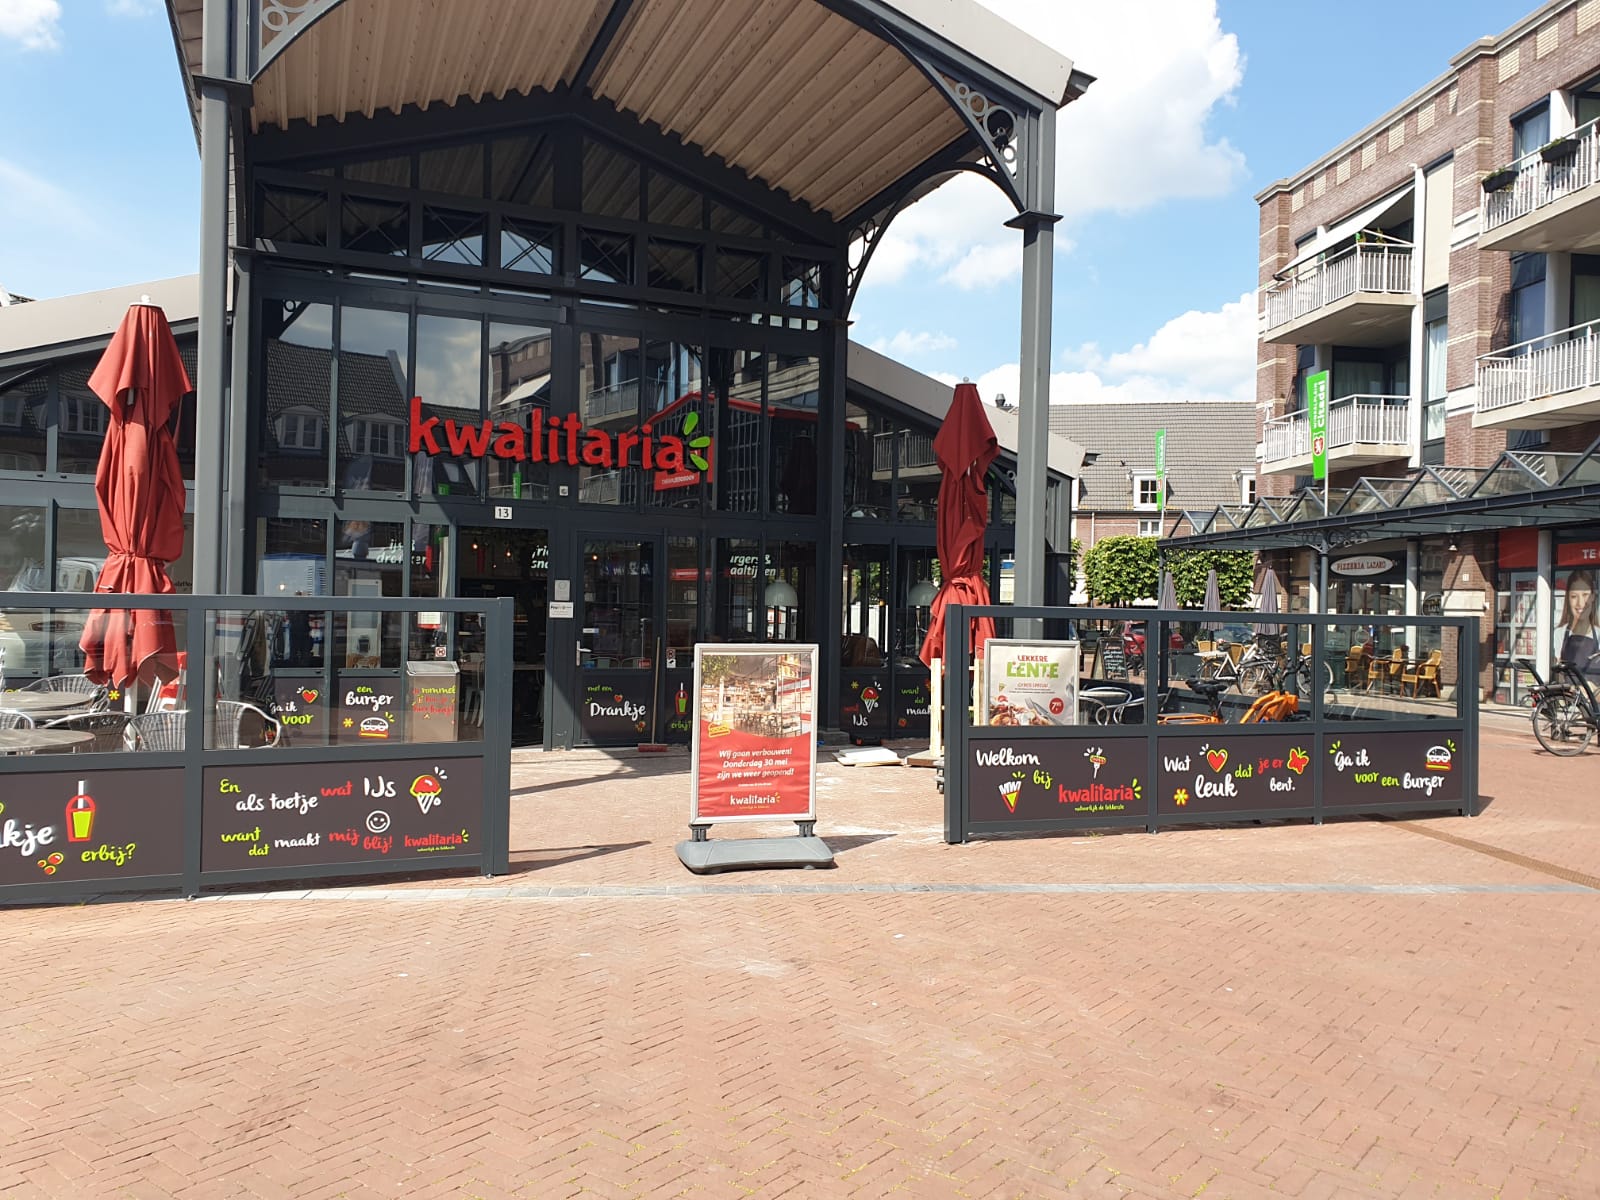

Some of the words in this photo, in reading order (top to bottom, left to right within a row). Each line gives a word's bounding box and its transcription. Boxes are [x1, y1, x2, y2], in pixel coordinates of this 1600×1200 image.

[408, 396, 684, 472] kwalitaria
[496, 508, 510, 519] 13
[1582, 549, 1596, 559] TE
[1007, 662, 1059, 678] LENTE
[356, 686, 373, 694] een
[901, 686, 920, 695] want
[285, 701, 297, 712] ik
[590, 701, 646, 721] Drankje
[906, 705, 931, 715] maak
[282, 714, 314, 725] voor
[719, 750, 732, 759] Wij
[733, 750, 750, 758] gaan
[752, 747, 792, 757] verbouwen!
[976, 747, 1040, 767] Welkom
[1334, 751, 1354, 772] Ga
[1355, 748, 1371, 767] ik
[723, 760, 763, 769] Donderdag
[775, 758, 788, 766] mei
[1163, 755, 1191, 772] Wat
[717, 771, 730, 780] zijn
[762, 768, 795, 778] geopend!
[1033, 769, 1053, 789] bij
[1194, 773, 1238, 798] leuk
[1234, 764, 1253, 778] dat
[1257, 758, 1270, 775] je
[1271, 759, 1284, 768] er
[1355, 772, 1379, 784] voor
[1381, 776, 1399, 787] een
[220, 778, 241, 793] En
[1269, 777, 1296, 791] bent.
[235, 793, 265, 811] als
[269, 792, 318, 815] toetje
[321, 781, 352, 796] wat
[730, 793, 776, 805] kwalitaria
[1058, 783, 1135, 803] kwalitaria
[0, 818, 56, 857] kje
[221, 826, 261, 842] want
[274, 832, 320, 848] maakt
[328, 828, 360, 846] mij
[248, 843, 269, 856] dat
[363, 835, 393, 854] blij!
[404, 833, 463, 847] kwalitaria
[81, 843, 136, 866] erbij?
